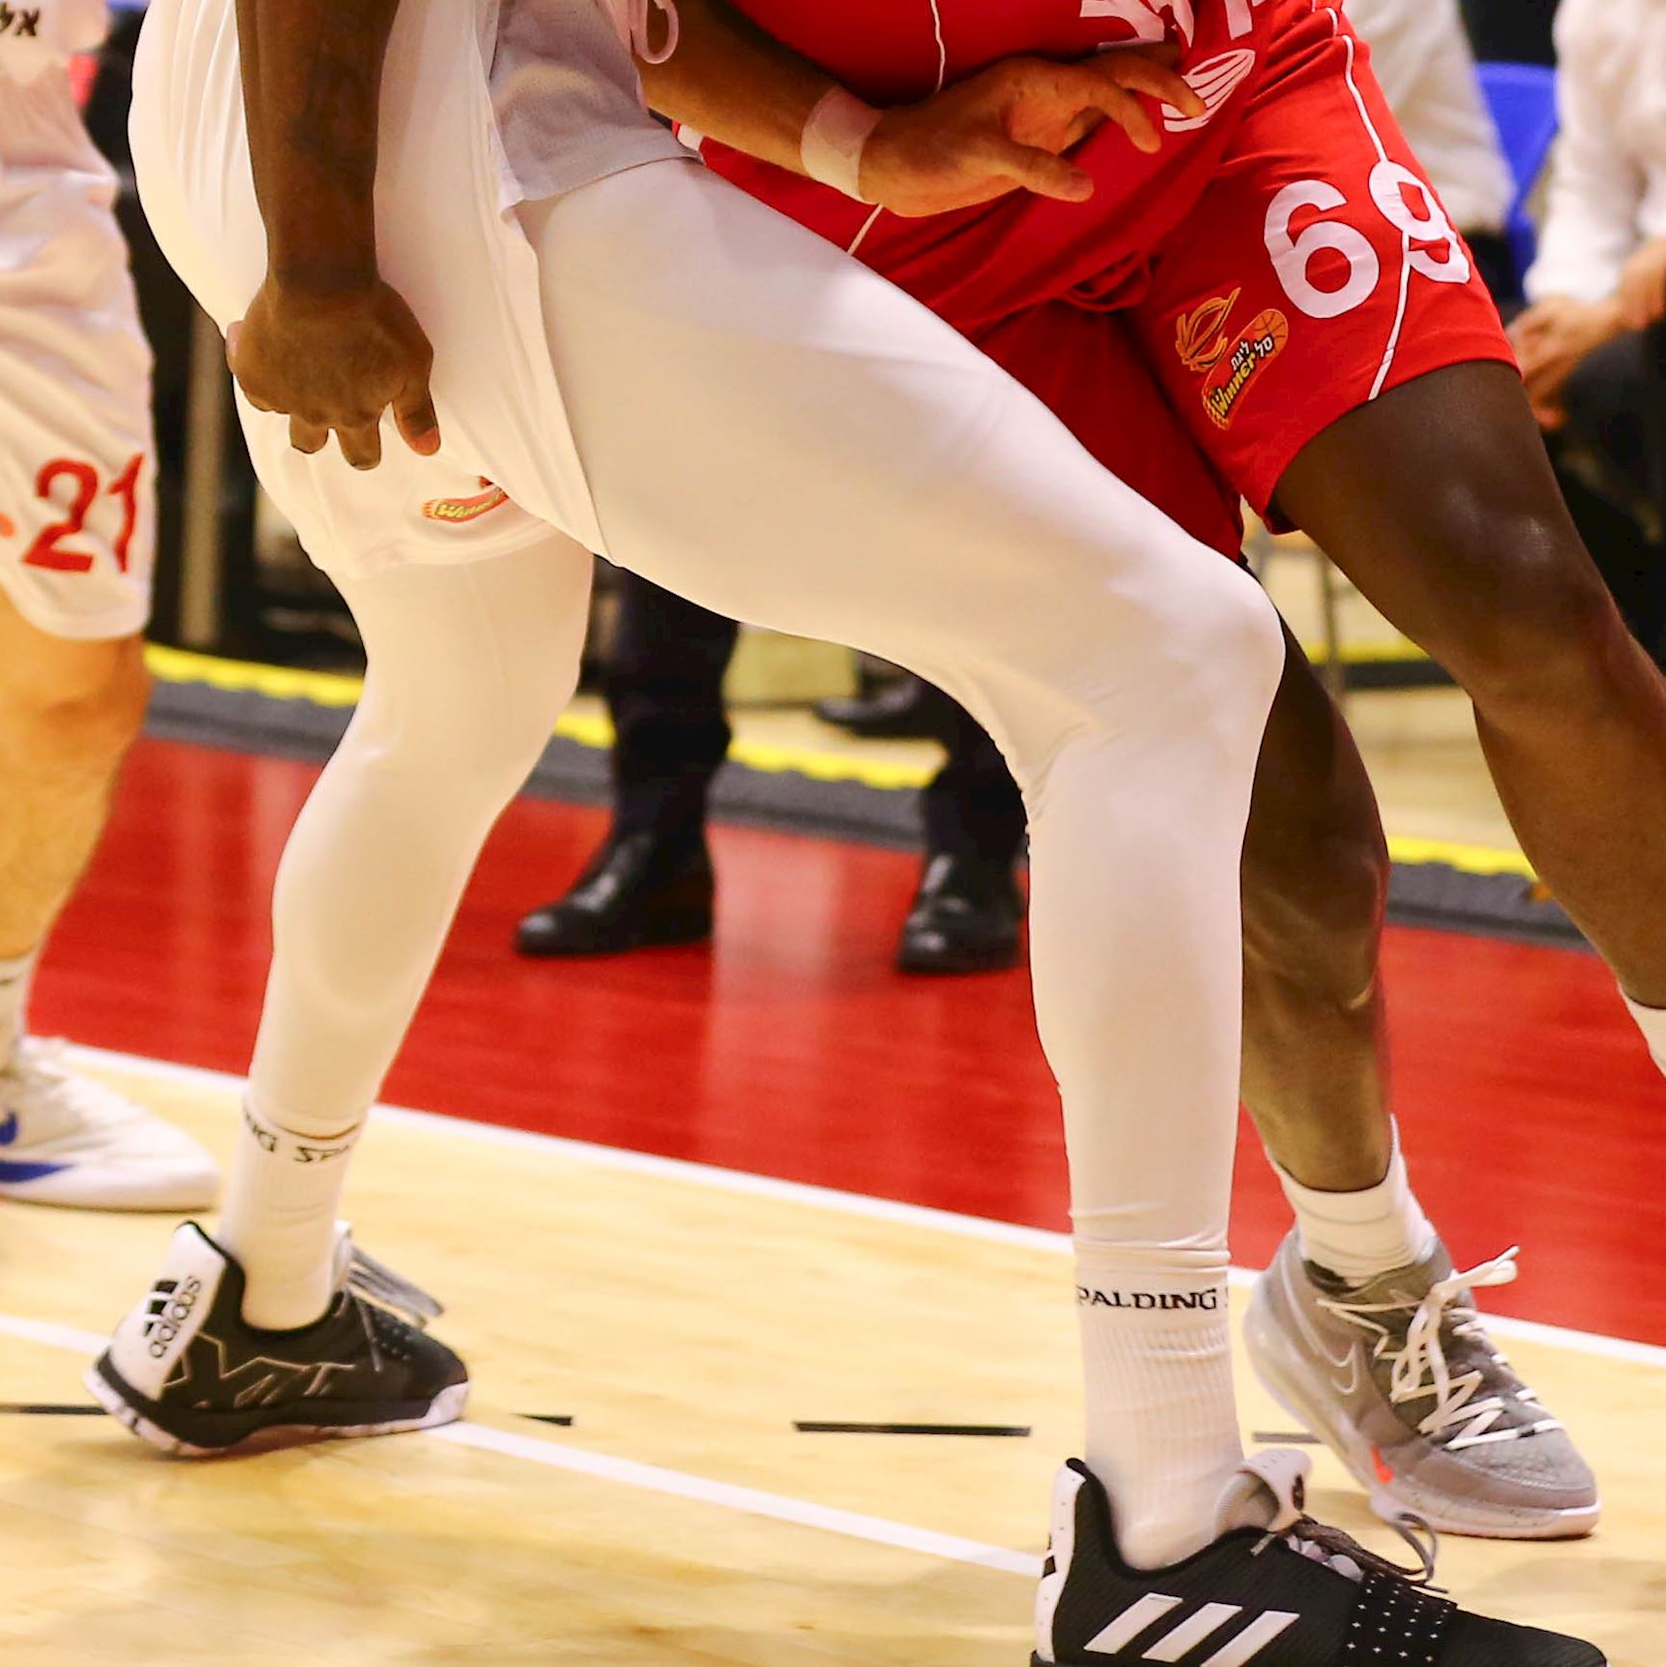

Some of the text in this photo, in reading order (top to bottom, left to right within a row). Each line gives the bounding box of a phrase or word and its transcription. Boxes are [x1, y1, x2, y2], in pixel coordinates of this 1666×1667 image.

[1263, 160, 1471, 319] 69
[1211, 351, 1257, 416] Winner
[1253, 335, 1274, 358] סל
[21, 451, 145, 575] 21
[148, 1275, 202, 1360] adidas
[1076, 1284, 1217, 1310] PALDING
